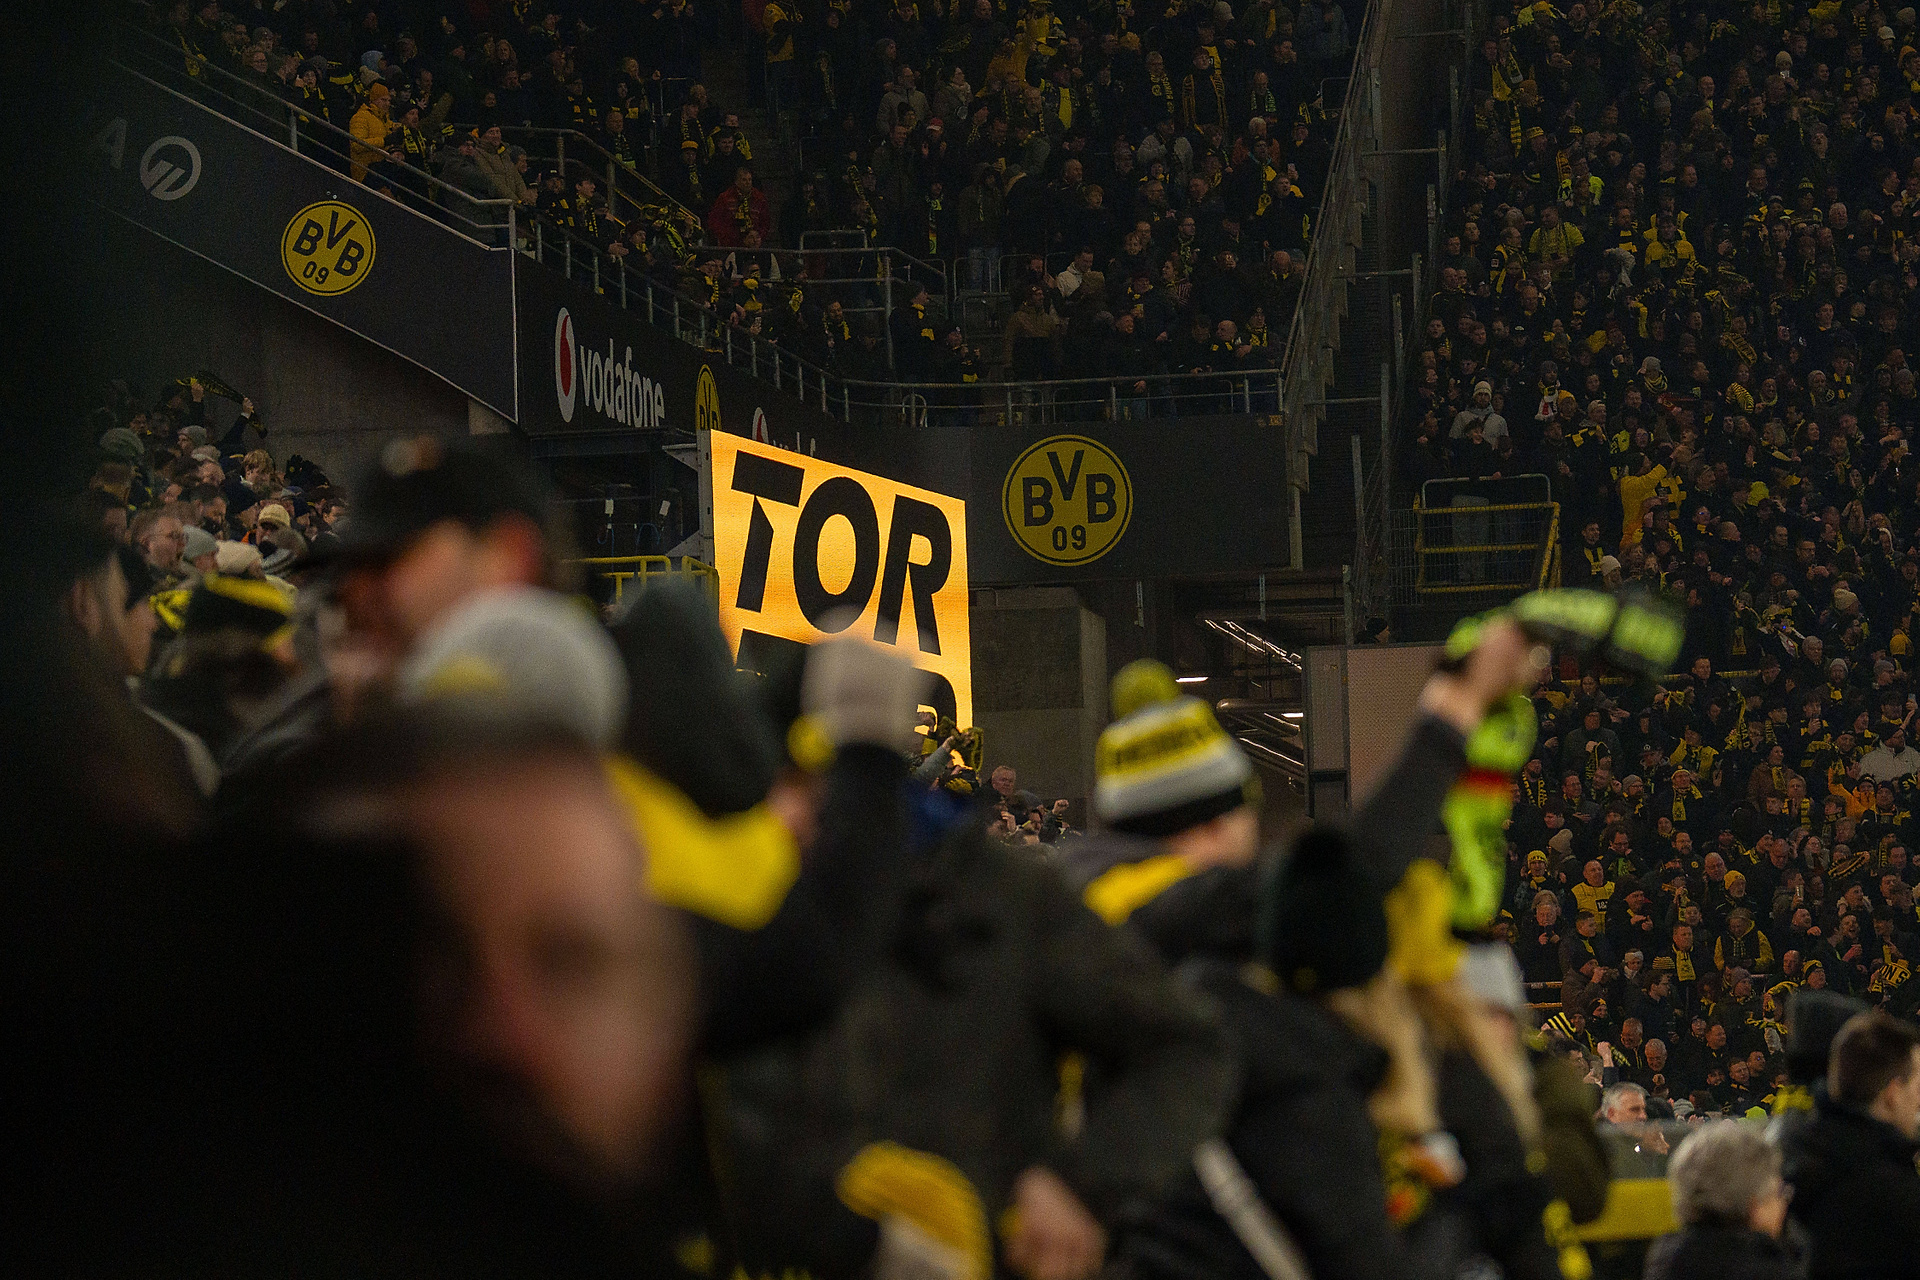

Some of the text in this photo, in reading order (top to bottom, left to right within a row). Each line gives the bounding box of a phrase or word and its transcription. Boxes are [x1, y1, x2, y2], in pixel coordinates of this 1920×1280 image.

[292, 209, 365, 277] BVB
[302, 260, 330, 285] 09
[579, 337, 666, 428] vodafone
[1021, 449, 1118, 528] BVB
[731, 449, 952, 656] TOR
[1051, 524, 1087, 552] 09
